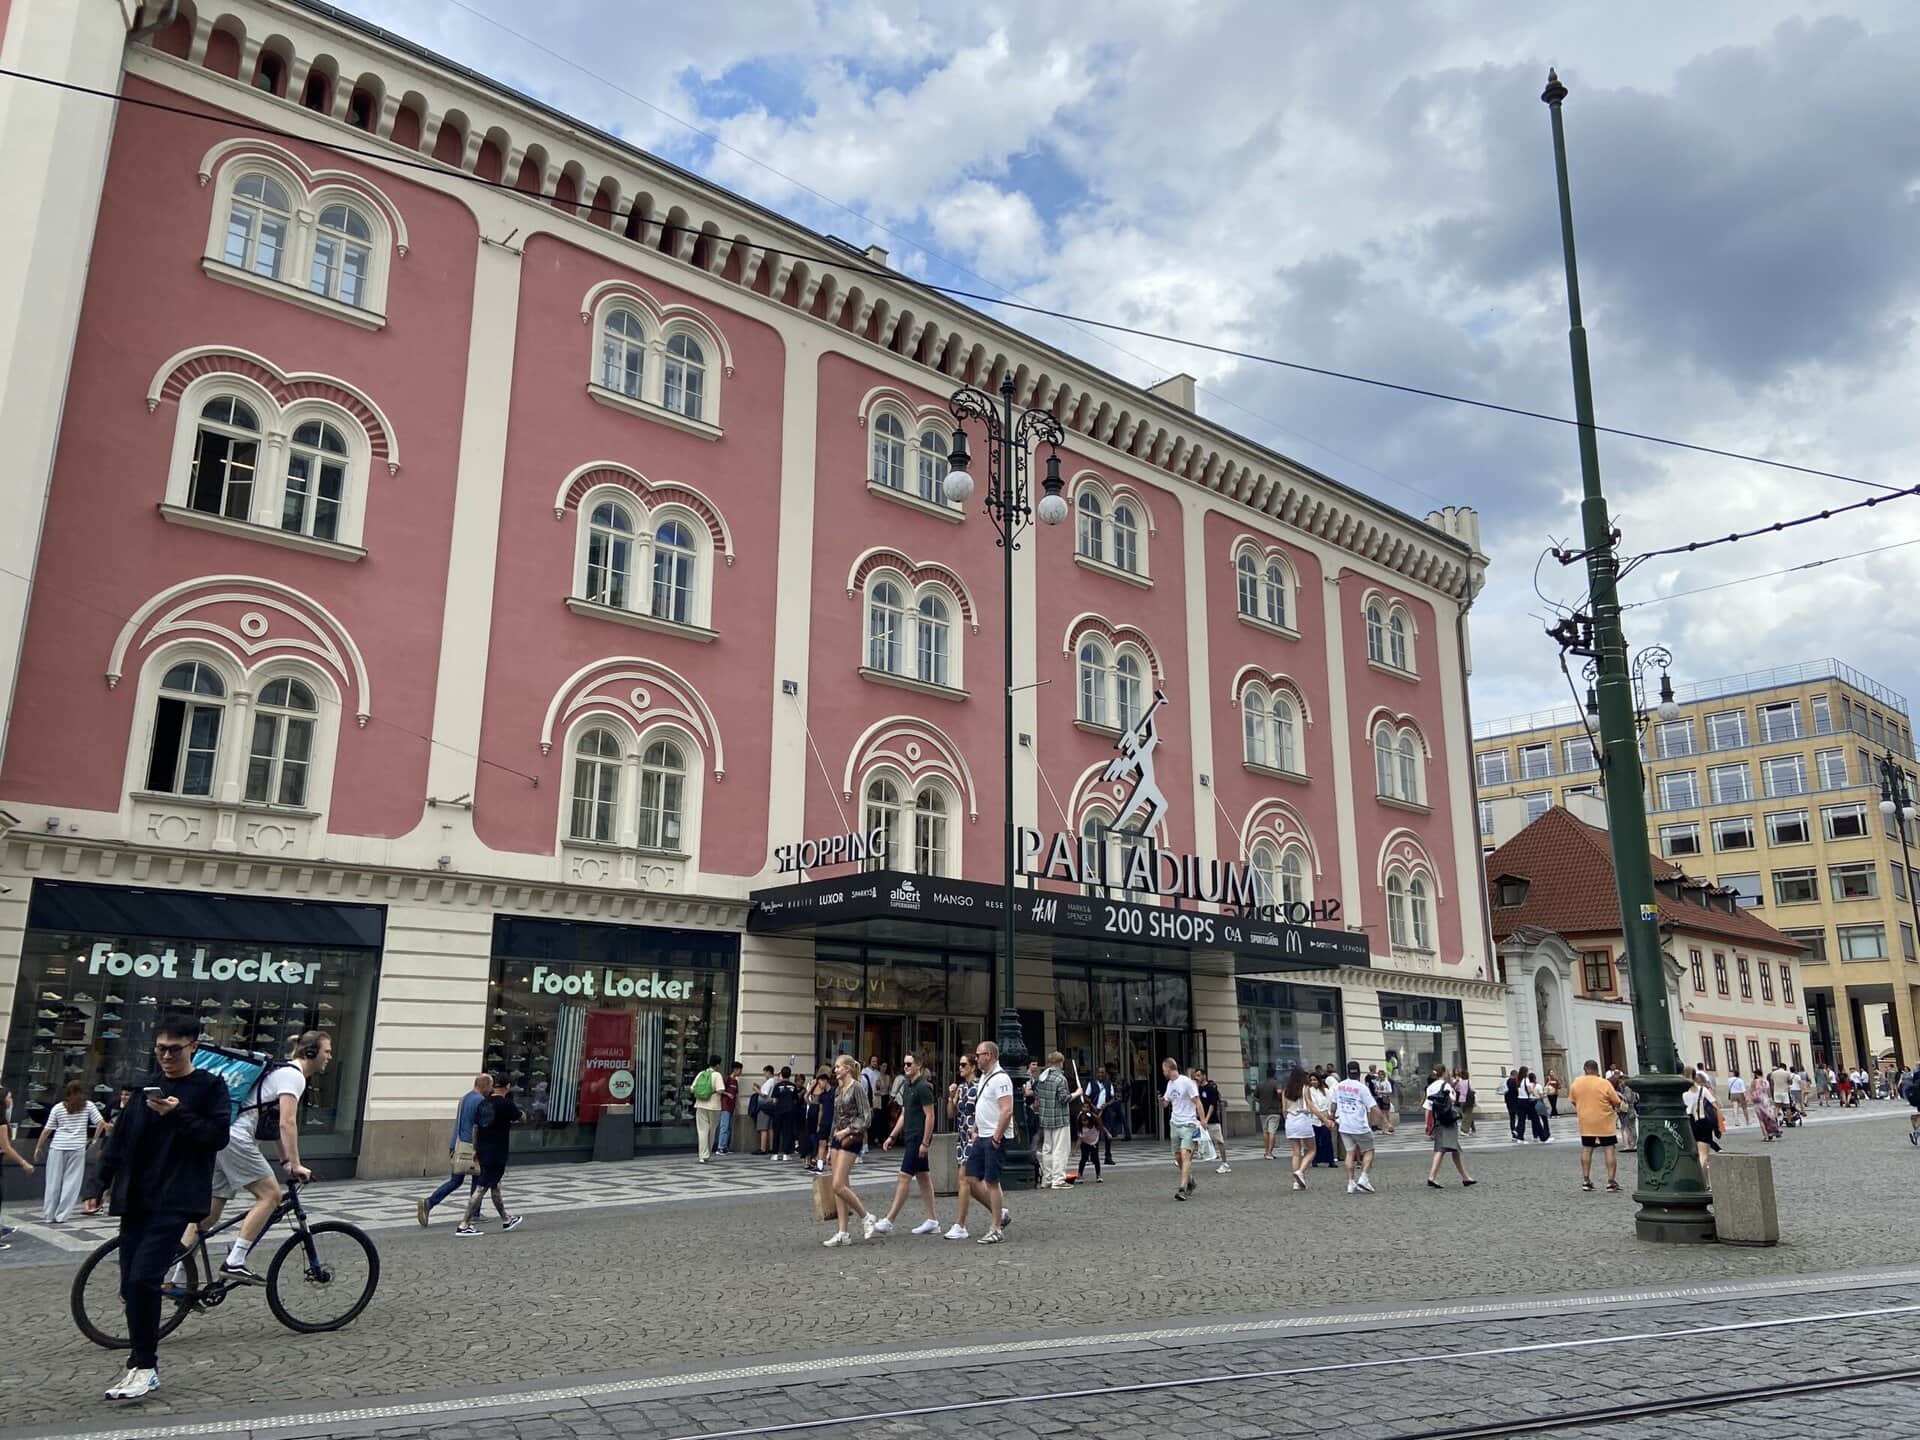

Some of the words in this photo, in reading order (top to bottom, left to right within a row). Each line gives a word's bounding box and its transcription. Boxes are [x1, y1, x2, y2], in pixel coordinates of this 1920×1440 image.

[774, 827, 888, 873] SHOPPING
[1018, 826, 1259, 907] PALLADIUM
[819, 893, 843, 905] LUXOR
[890, 888, 920, 902] albert
[933, 893, 974, 907] MANGO
[985, 901, 1022, 911] RESEED
[1031, 897, 1058, 924] H&M
[1104, 906, 1142, 935] 200
[1149, 911, 1215, 943] SHOPS
[87, 943, 178, 979] Foot
[192, 948, 322, 985] Locker
[531, 966, 595, 995] Foot
[604, 968, 694, 1000] Locker
[586, 1057, 630, 1069] VÝPRODEJ
